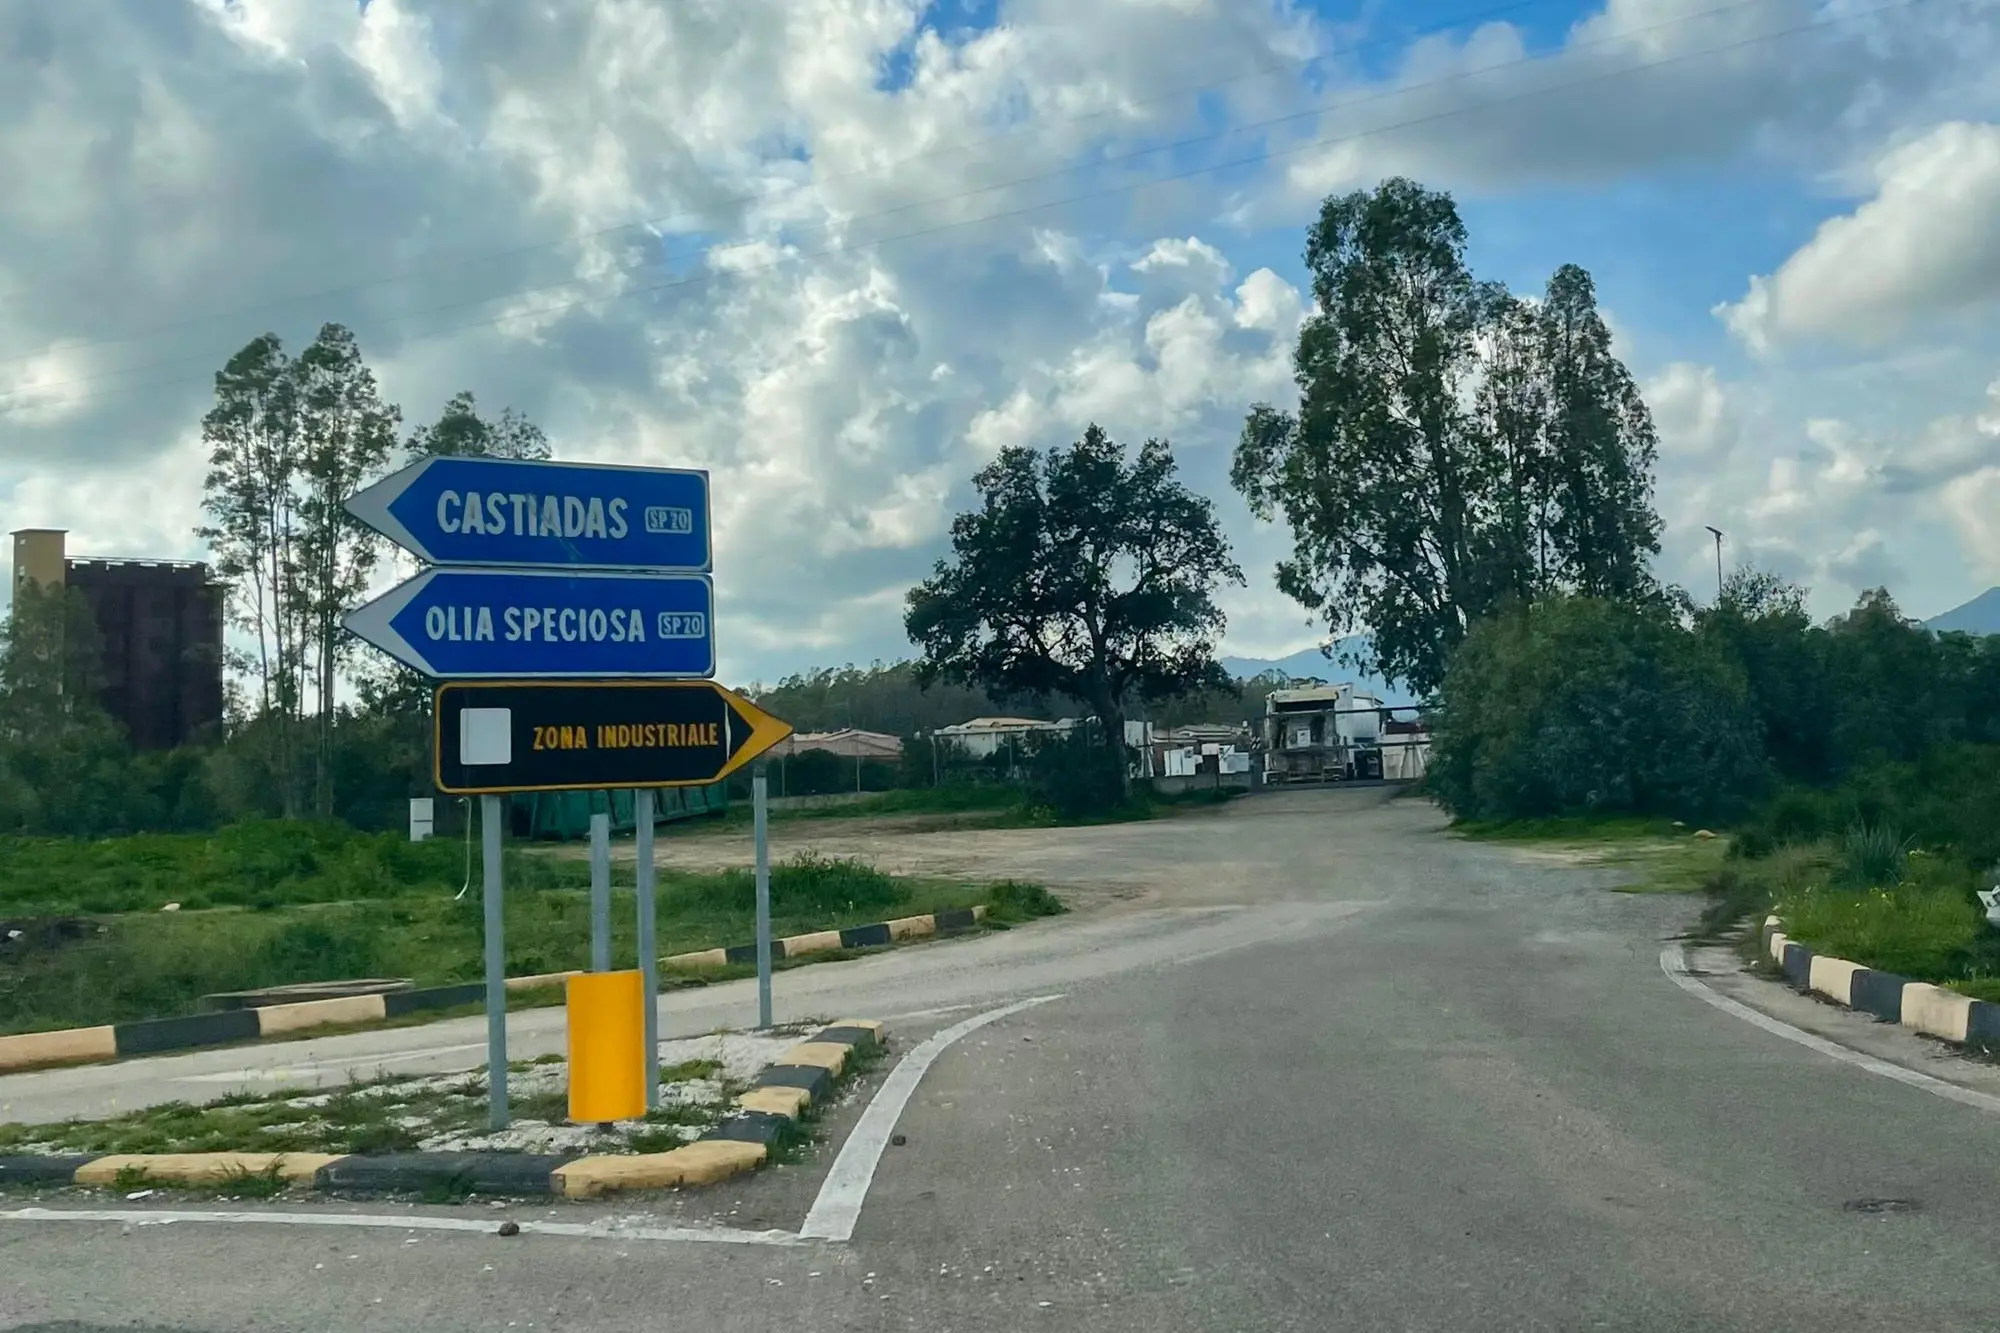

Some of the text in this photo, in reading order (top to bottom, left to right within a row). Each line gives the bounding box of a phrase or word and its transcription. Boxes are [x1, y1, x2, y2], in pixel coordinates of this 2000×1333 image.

[437, 489, 628, 539] CASTIADAS
[425, 605, 645, 642] OLIA SPECIOSA
[533, 723, 719, 750] ZONA INDUSTRIALE
